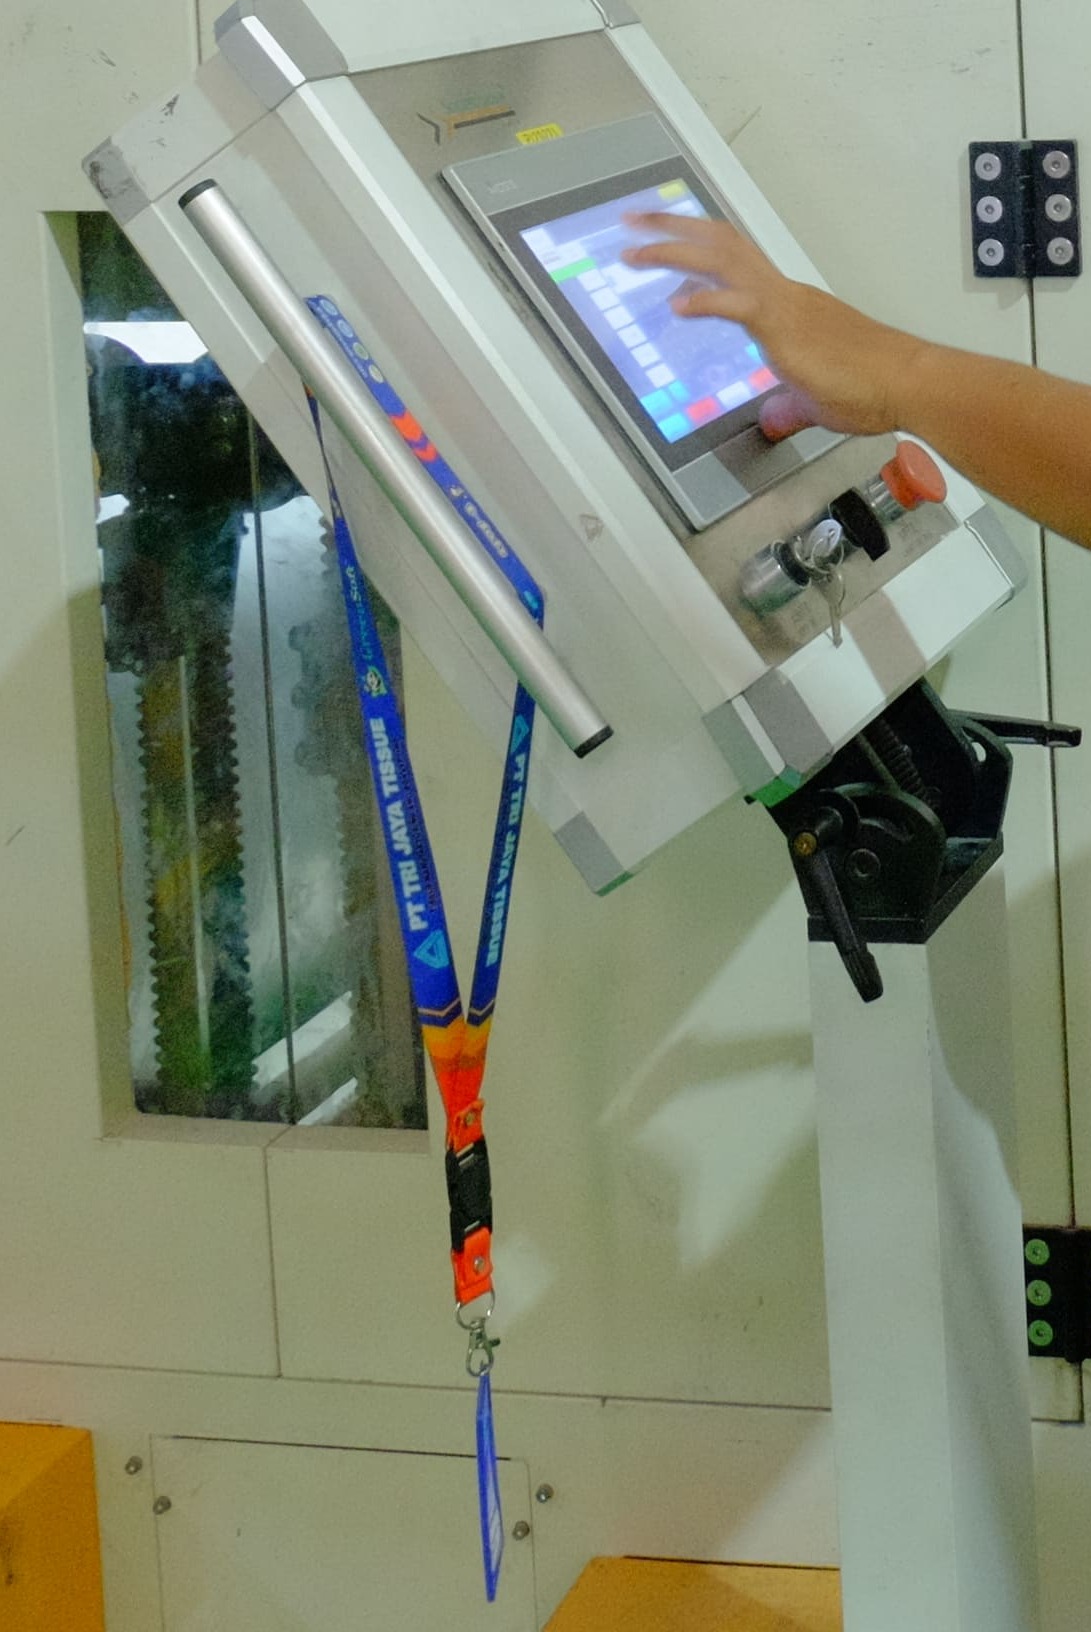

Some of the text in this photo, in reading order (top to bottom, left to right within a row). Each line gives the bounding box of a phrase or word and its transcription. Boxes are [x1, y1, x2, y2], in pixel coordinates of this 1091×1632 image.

[369, 717, 400, 799] TISSUE
[386, 800, 413, 856] JAYA
[398, 860, 422, 897] TRI
[485, 752, 526, 968] PT TRI JAYA TISSUE
[407, 899, 429, 931] PT
